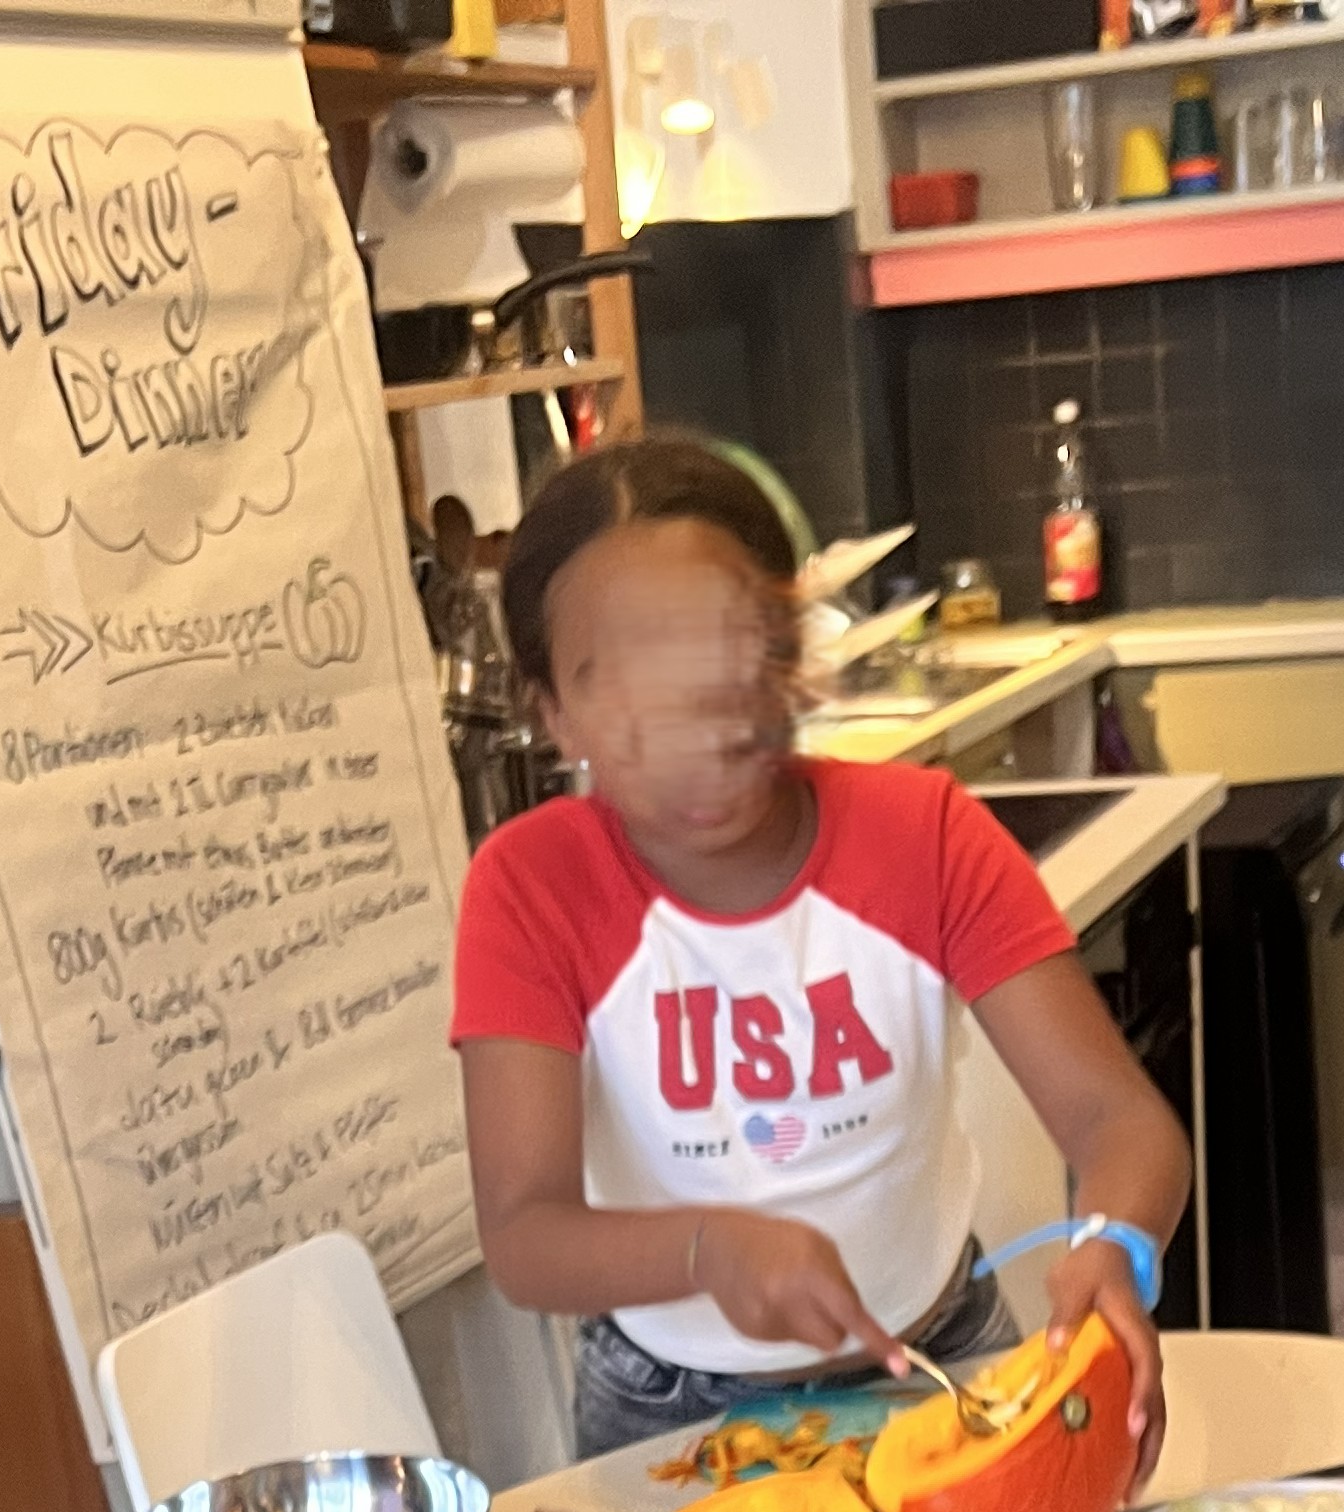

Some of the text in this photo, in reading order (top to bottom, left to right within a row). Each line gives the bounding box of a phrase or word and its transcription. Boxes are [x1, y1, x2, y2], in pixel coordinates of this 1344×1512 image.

[52, 338, 268, 457] Dinner
[2, 727, 26, 784] 8
[87, 1010, 118, 1046] 2
[654, 971, 894, 1111] USA
